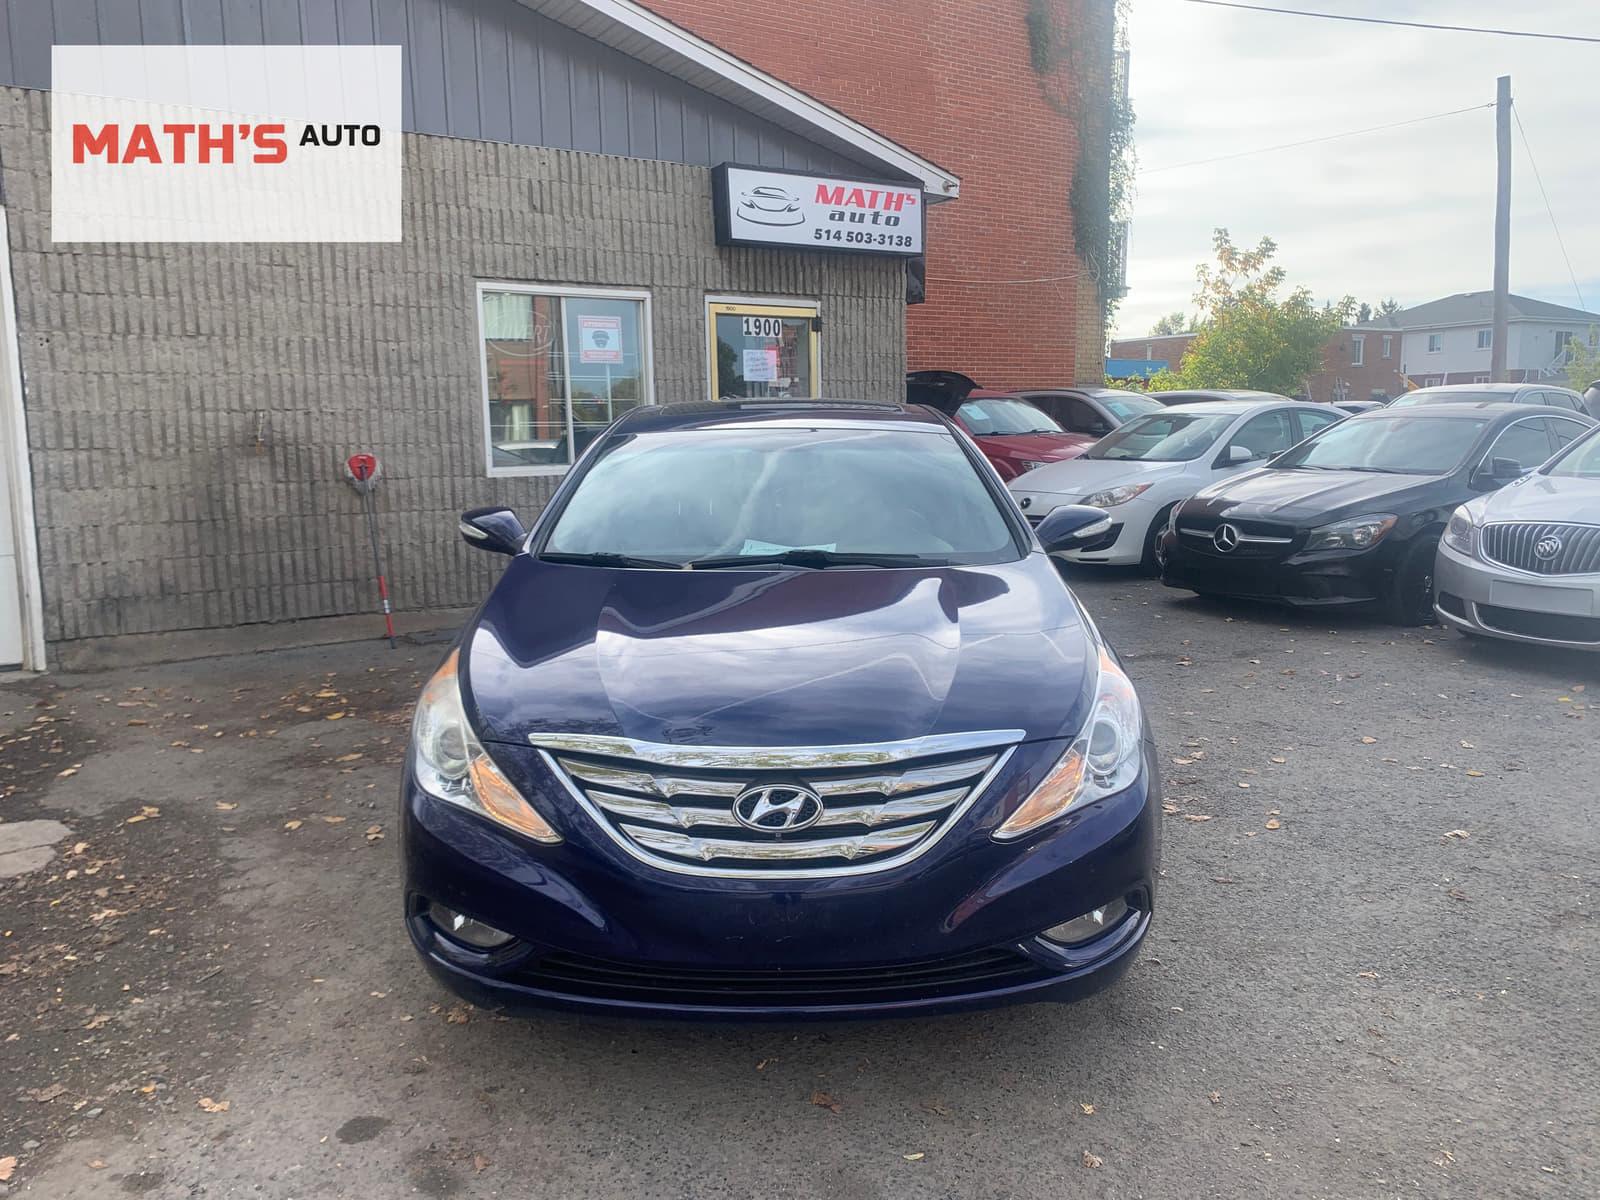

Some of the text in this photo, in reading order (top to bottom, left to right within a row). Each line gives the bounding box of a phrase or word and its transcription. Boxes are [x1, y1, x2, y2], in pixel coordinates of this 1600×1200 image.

[828, 210, 900, 227] auto
[813, 228, 912, 247] 514 503-3138
[743, 318, 781, 337] 1900
